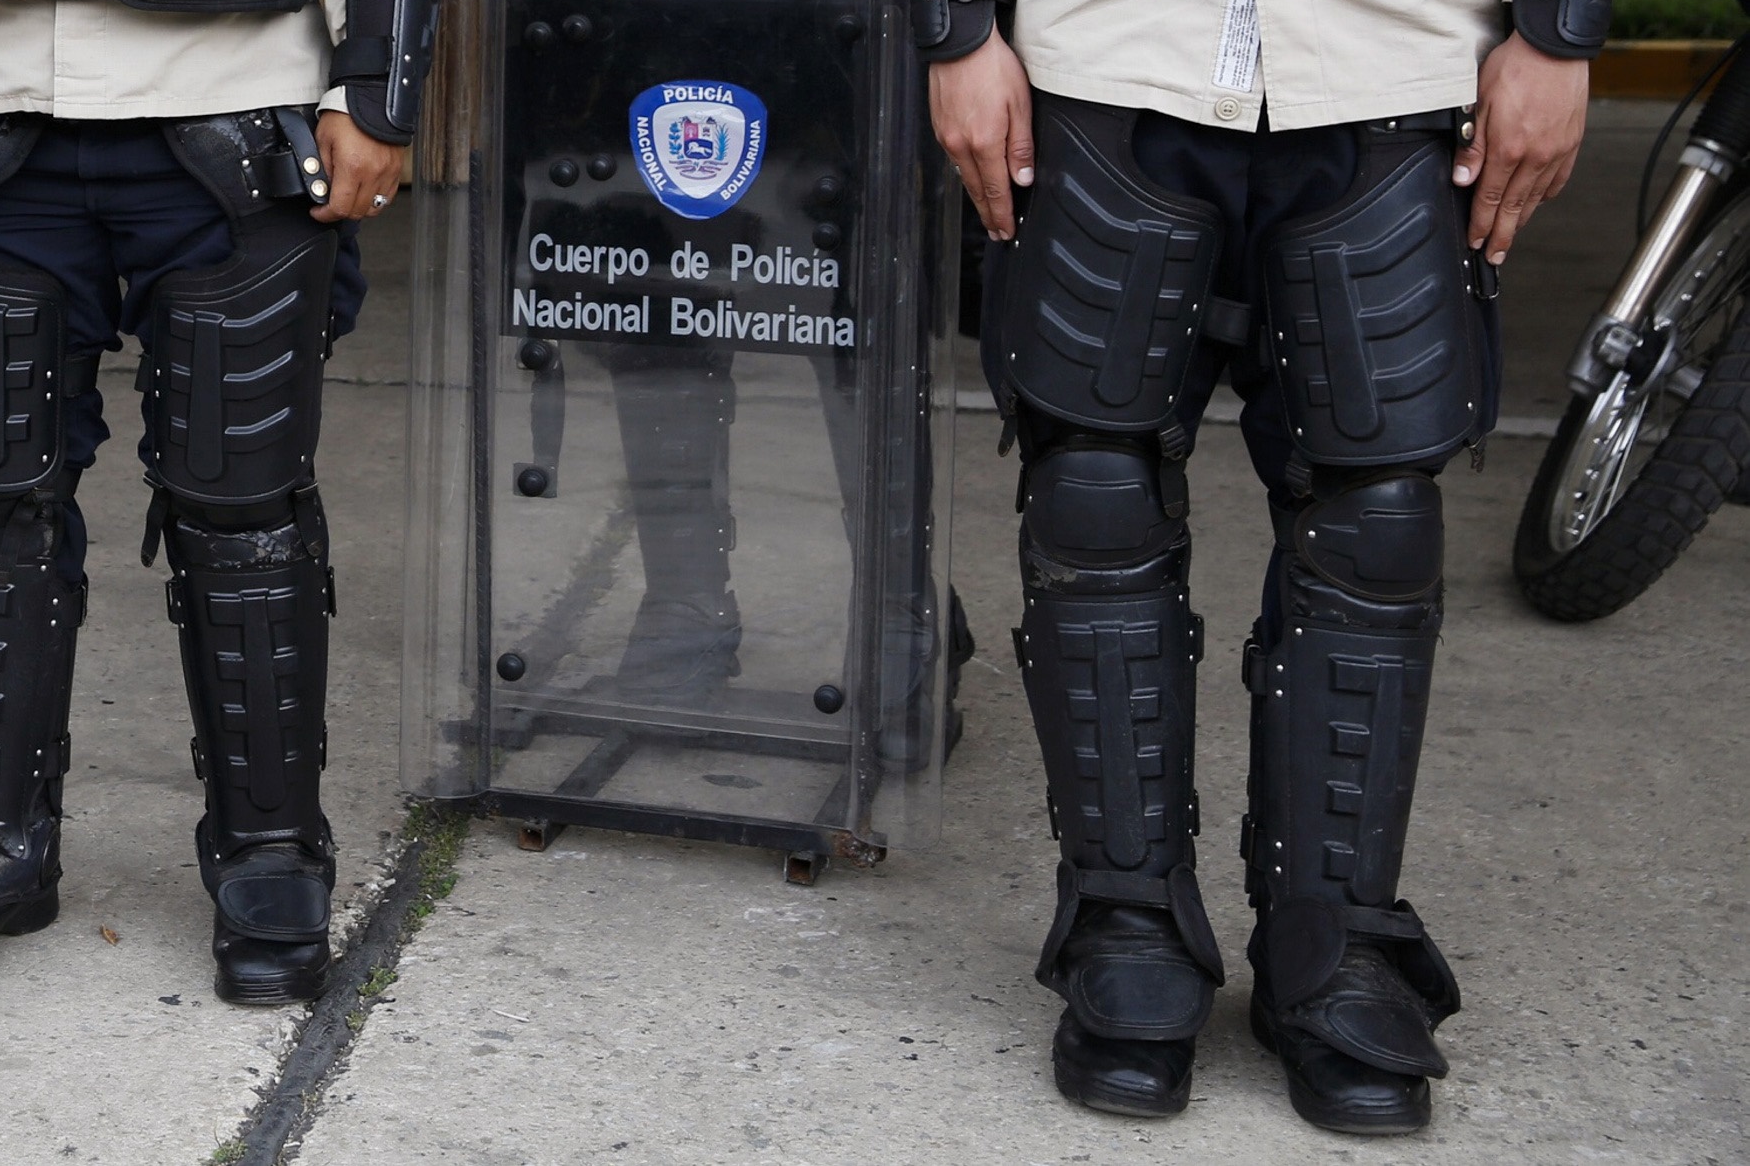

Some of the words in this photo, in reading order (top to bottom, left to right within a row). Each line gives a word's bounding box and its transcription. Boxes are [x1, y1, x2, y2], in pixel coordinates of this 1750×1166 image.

[663, 86, 734, 104] POLICÍA
[636, 116, 668, 192] NACIONAL
[719, 120, 761, 201] BOLIVARIANA
[529, 233, 650, 284] Cuerpo
[670, 241, 710, 280] de
[731, 243, 840, 289] Policía
[513, 288, 649, 334] Nacional
[670, 297, 856, 347] Bolivariana
